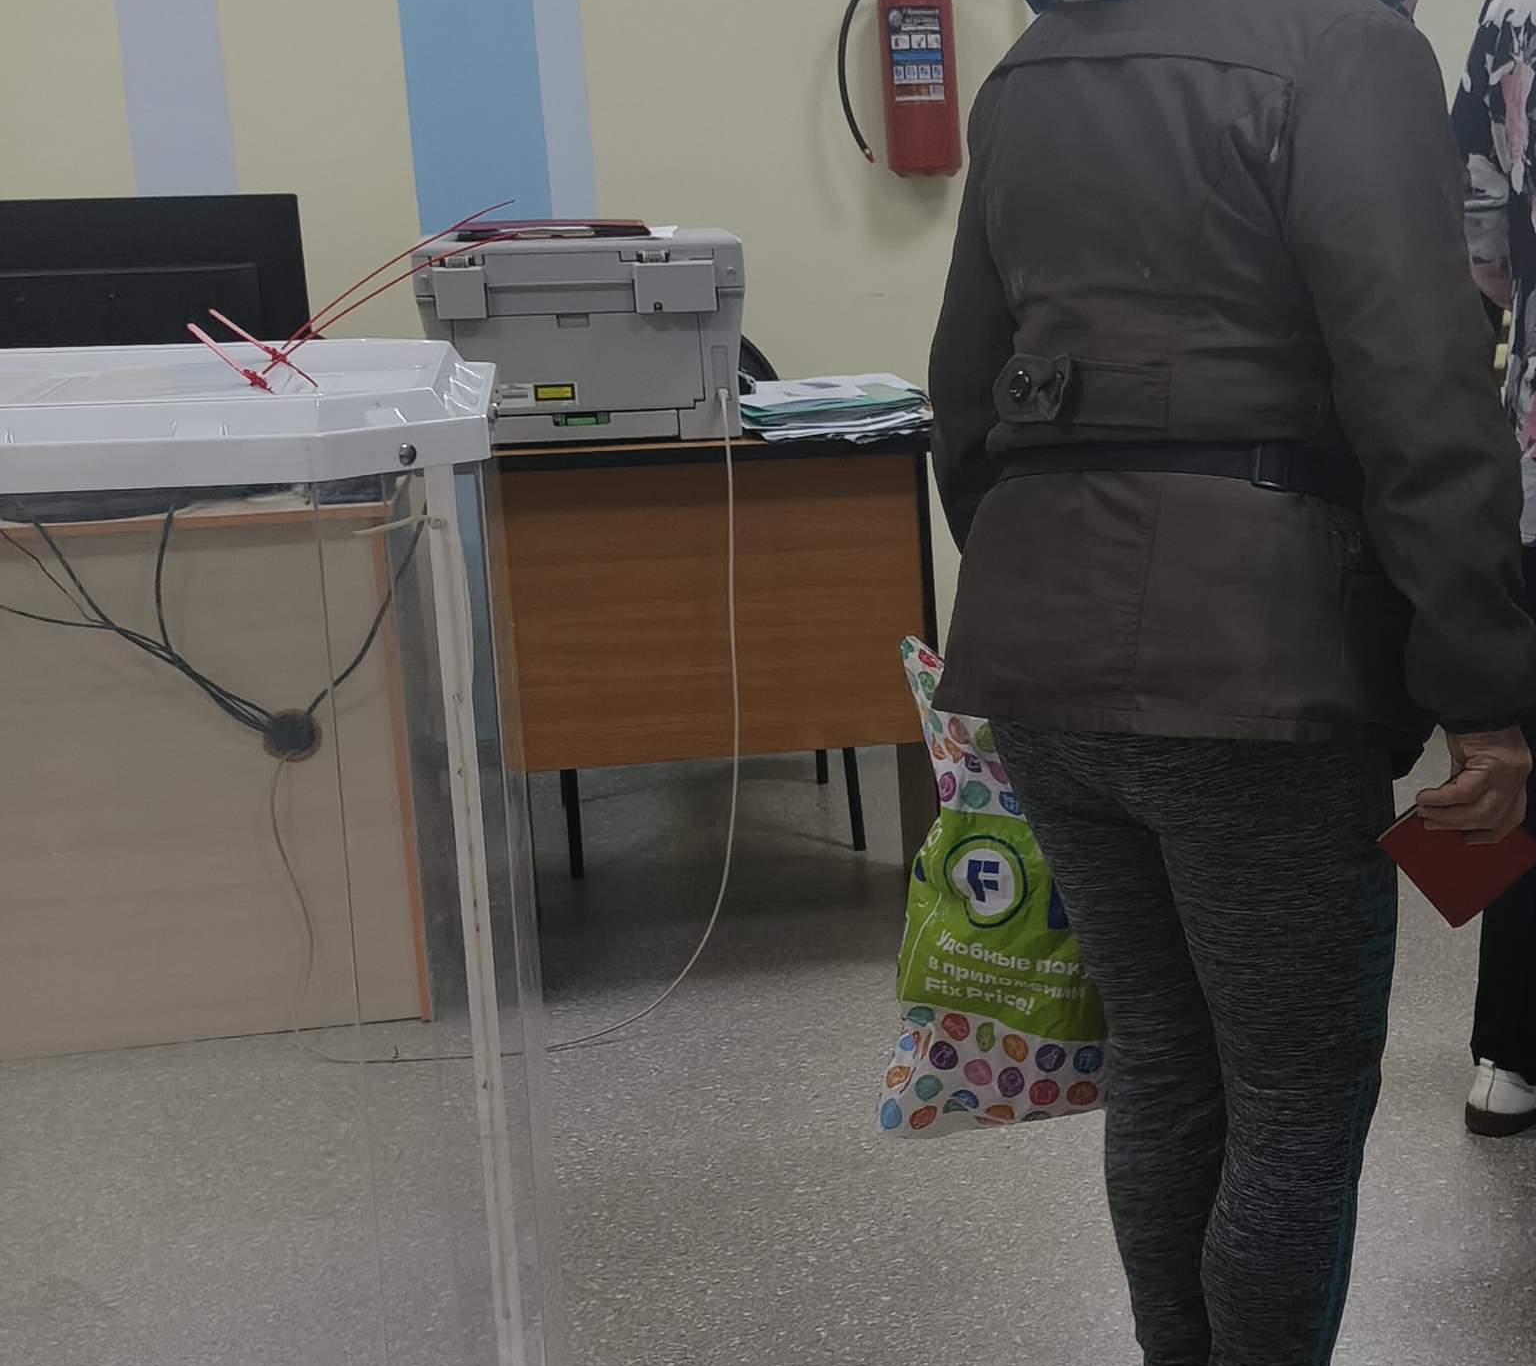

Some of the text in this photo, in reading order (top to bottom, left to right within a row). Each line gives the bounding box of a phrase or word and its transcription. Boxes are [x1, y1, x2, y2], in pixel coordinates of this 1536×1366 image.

[936, 929, 1031, 972] Удобные
[924, 976, 1036, 1016] Fix Price!
